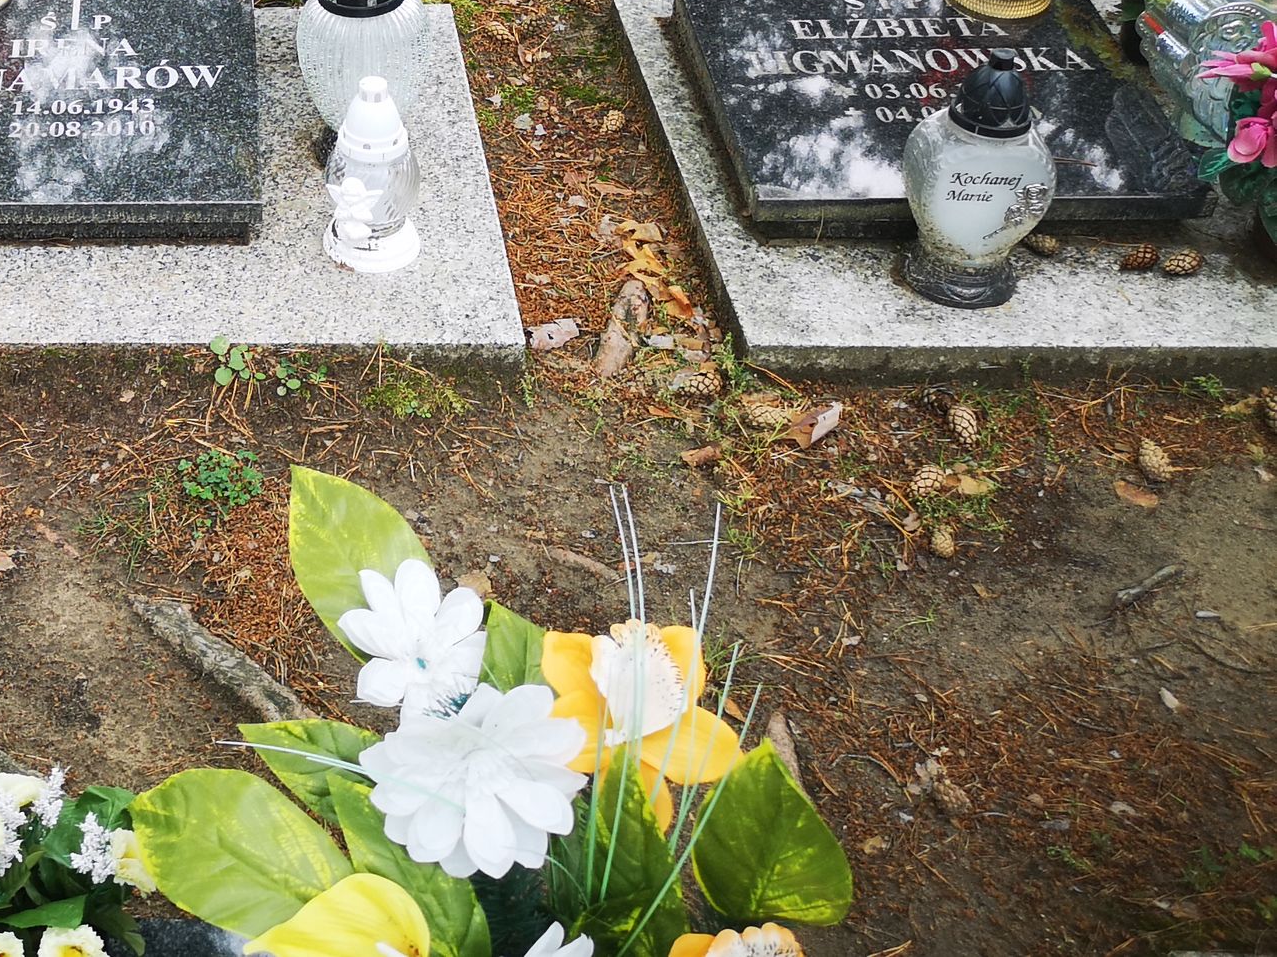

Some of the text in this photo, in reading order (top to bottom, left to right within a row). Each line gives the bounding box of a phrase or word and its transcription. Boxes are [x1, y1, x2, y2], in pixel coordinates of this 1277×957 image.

[91, 13, 113, 31] P
[789, 13, 1010, 40] ELŻBIETA
[8, 36, 140, 59] IRENA
[12, 98, 156, 116] 14.06.1943
[8, 121, 157, 139] 20.08.2010
[950, 171, 1024, 191] Kochanej
